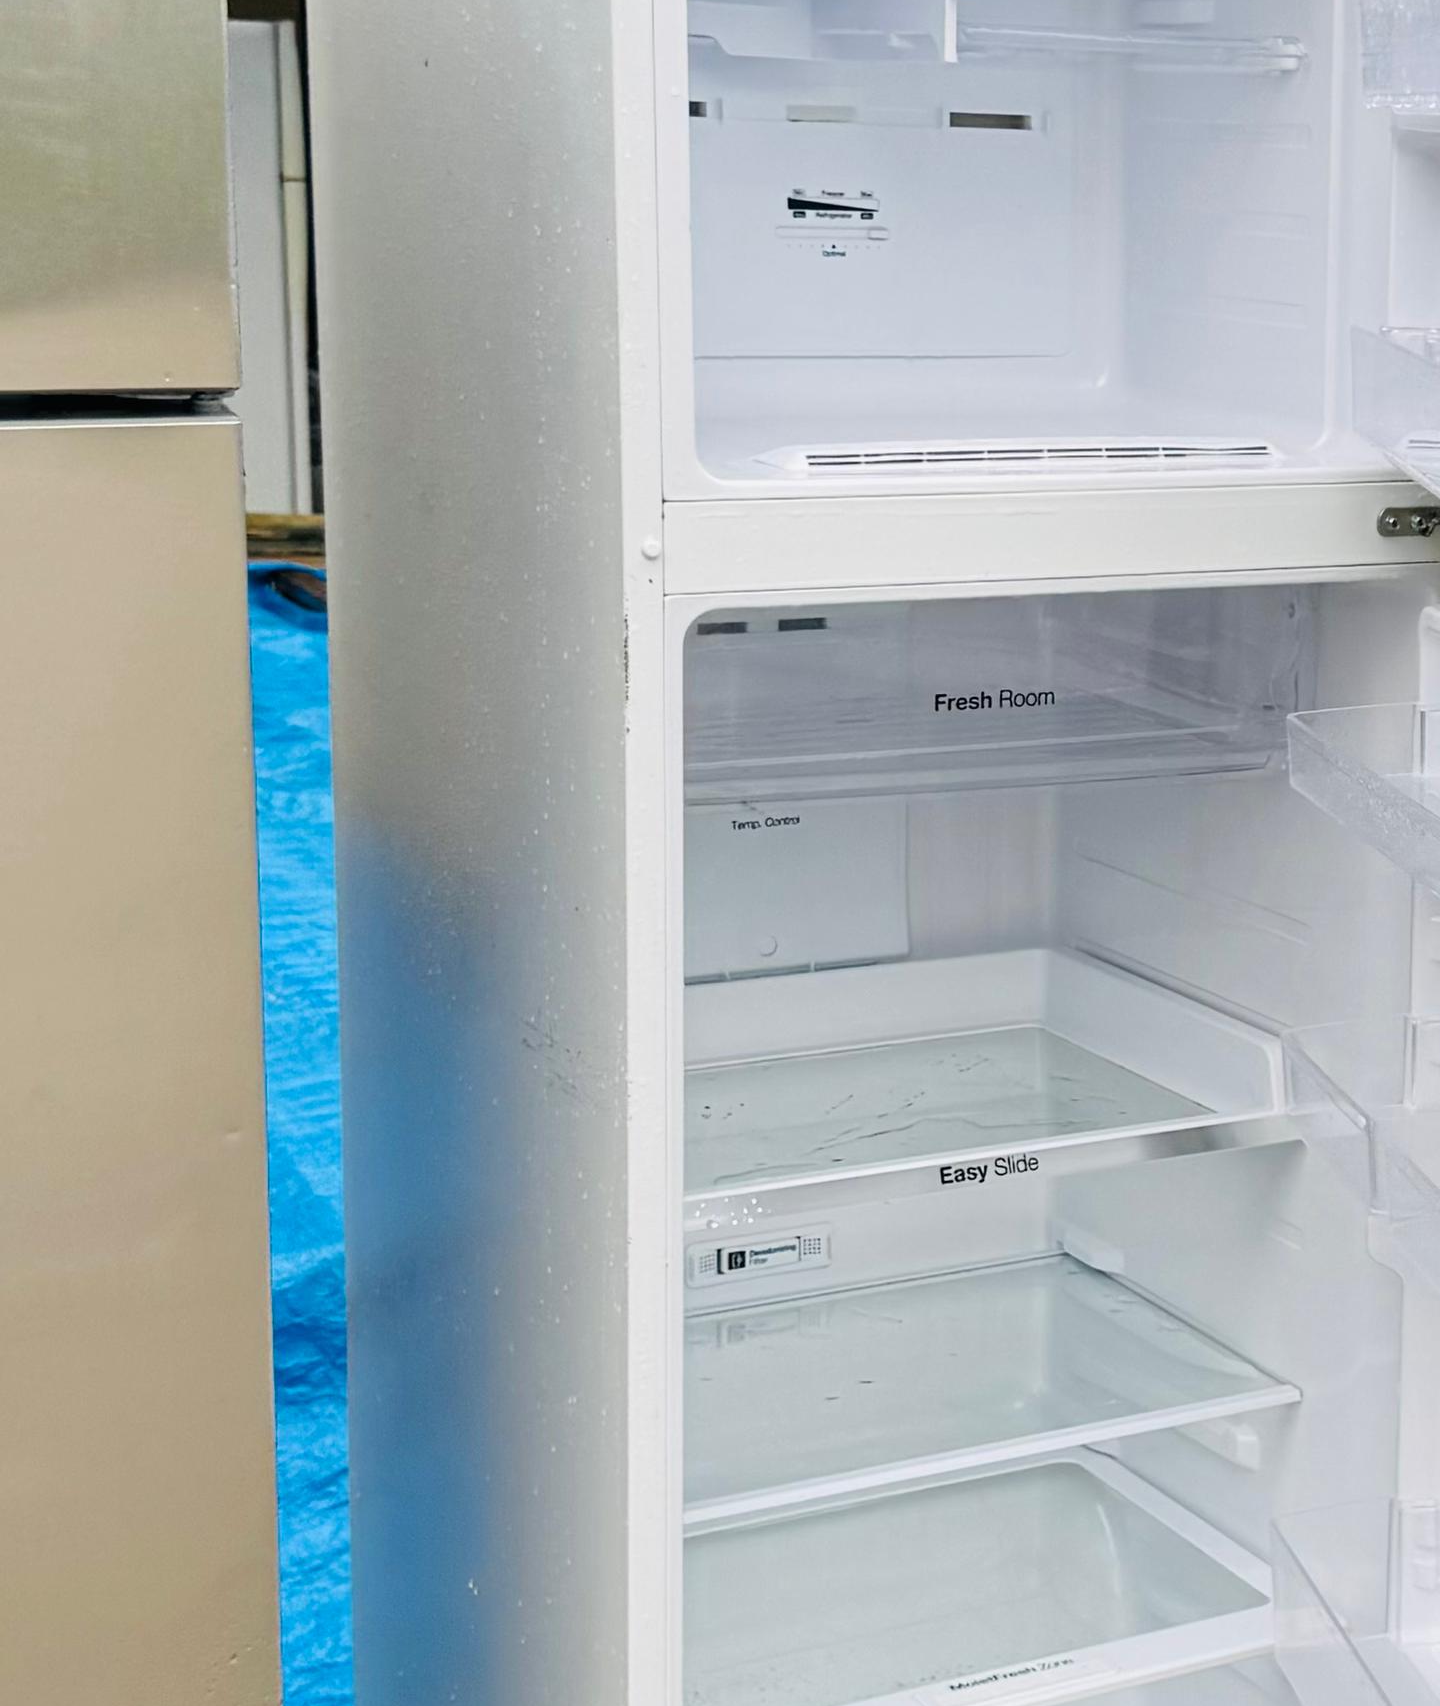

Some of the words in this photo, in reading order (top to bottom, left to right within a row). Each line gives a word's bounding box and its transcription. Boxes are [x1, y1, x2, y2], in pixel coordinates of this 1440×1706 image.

[934, 691, 993, 712] Fresh
[999, 689, 1055, 708] Room
[940, 1165, 988, 1185] Easy
[994, 1153, 1039, 1176] Slide
